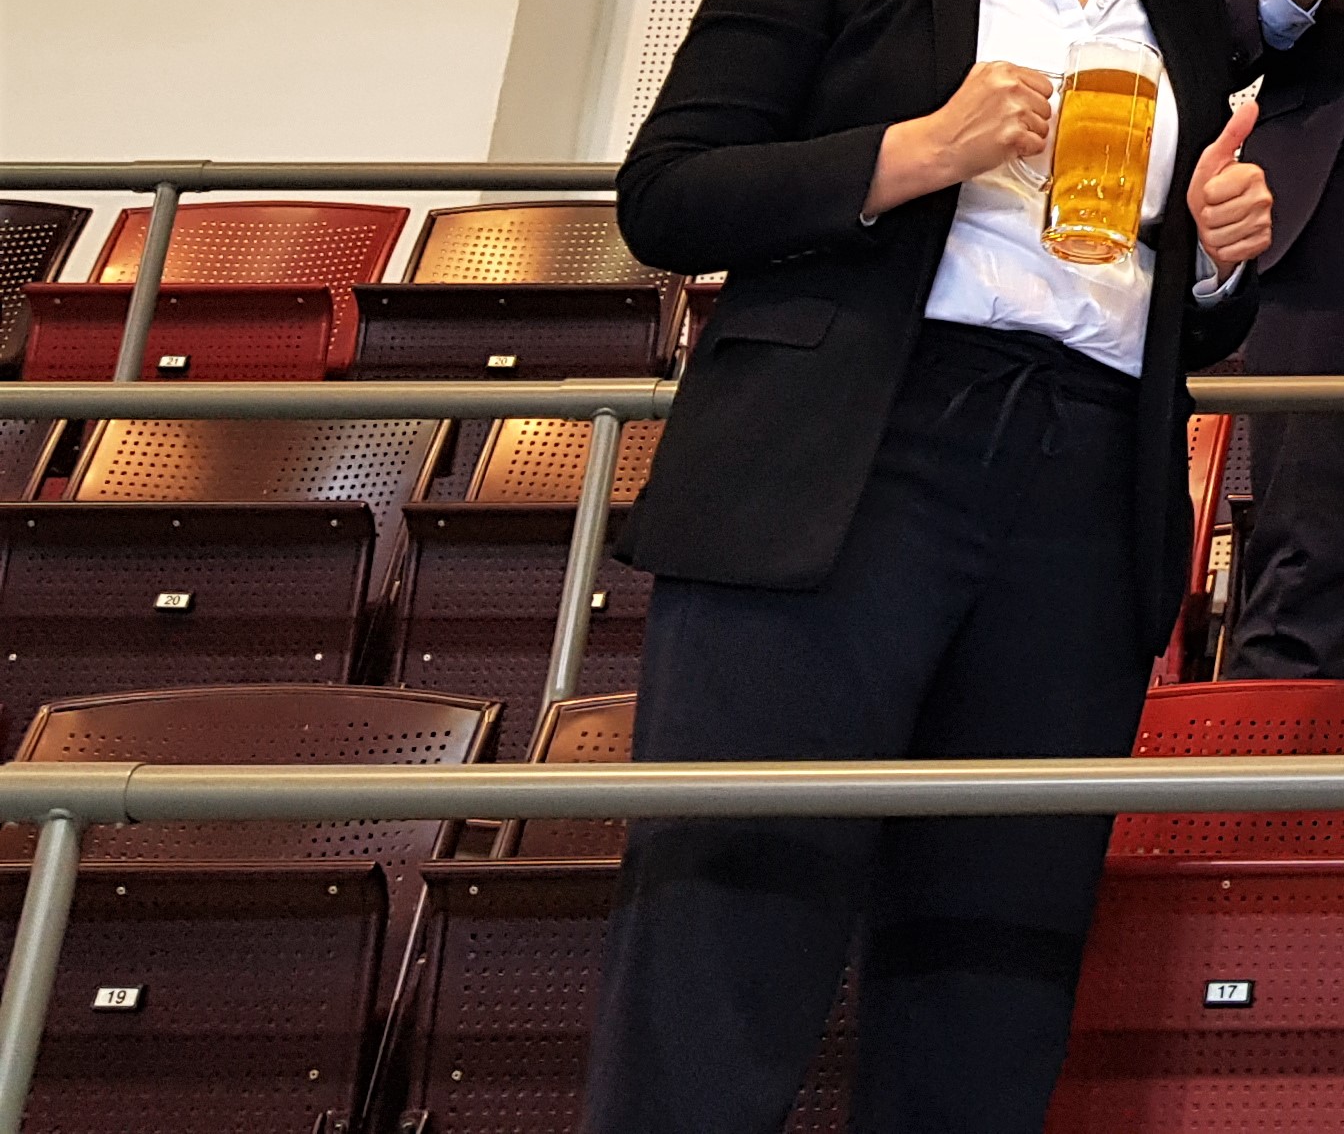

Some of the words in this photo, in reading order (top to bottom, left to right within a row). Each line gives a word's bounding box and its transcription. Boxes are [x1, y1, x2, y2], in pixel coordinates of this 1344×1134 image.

[164, 595, 181, 606] 20
[107, 989, 127, 1005] 19
[1217, 984, 1237, 1000] 17
